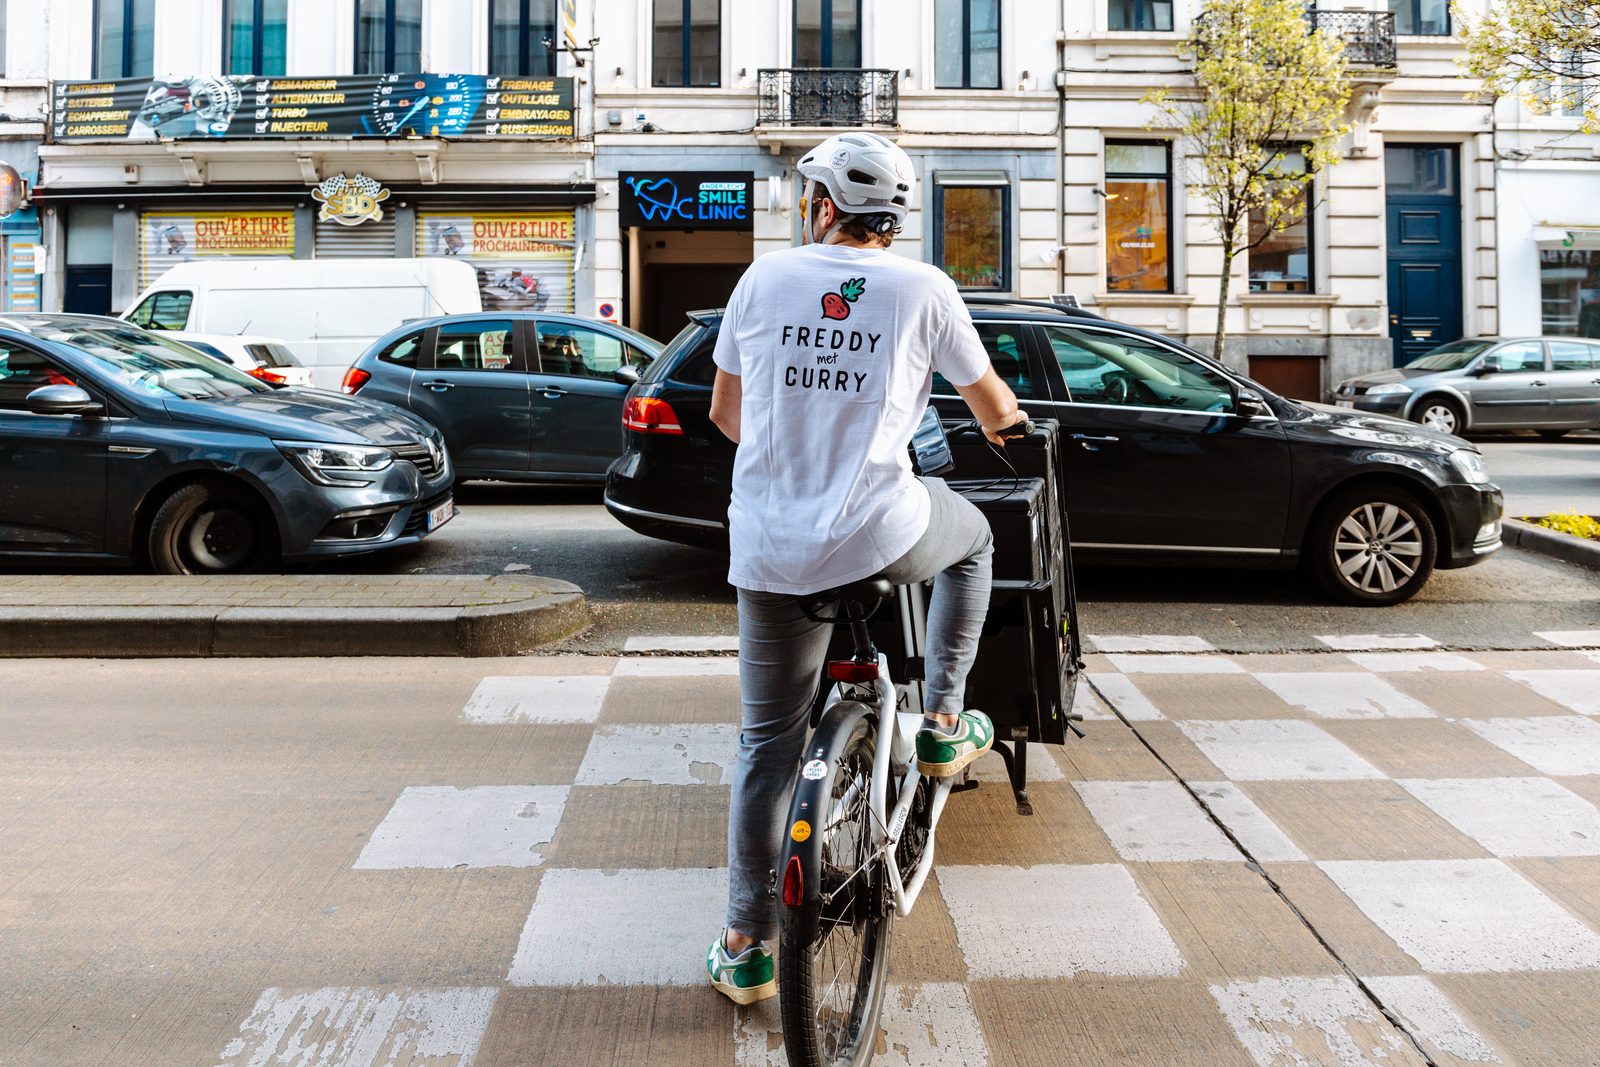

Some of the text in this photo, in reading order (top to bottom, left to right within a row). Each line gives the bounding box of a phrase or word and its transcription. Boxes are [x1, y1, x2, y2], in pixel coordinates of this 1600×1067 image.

[68, 84, 116, 95] ENTRETIEN
[271, 80, 338, 90] DEMARREUR
[501, 80, 555, 91] FREINAGE
[67, 98, 114, 109] BATTERIES
[271, 93, 346, 104] ALTERNATEUR
[501, 94, 561, 105] OUTILLAGE
[67, 110, 131, 122] ECHAPPEMENT
[271, 107, 308, 118] TURBO
[500, 108, 571, 120] EMBRAYAGES
[67, 124, 128, 136] CARROSSERIE
[270, 121, 329, 132] INJECTEUR
[501, 125, 574, 136] SUSPENSIONS
[698, 191, 746, 204] SMILE
[326, 195, 376, 216] SBD
[195, 217, 289, 236] OUVERTURE
[473, 221, 568, 239] OUVERTURE
[195, 236, 289, 249] PROCHAINEMENT
[781, 325, 882, 354] FREDDY
[816, 352, 839, 365] met
[785, 366, 868, 393] CURRY
